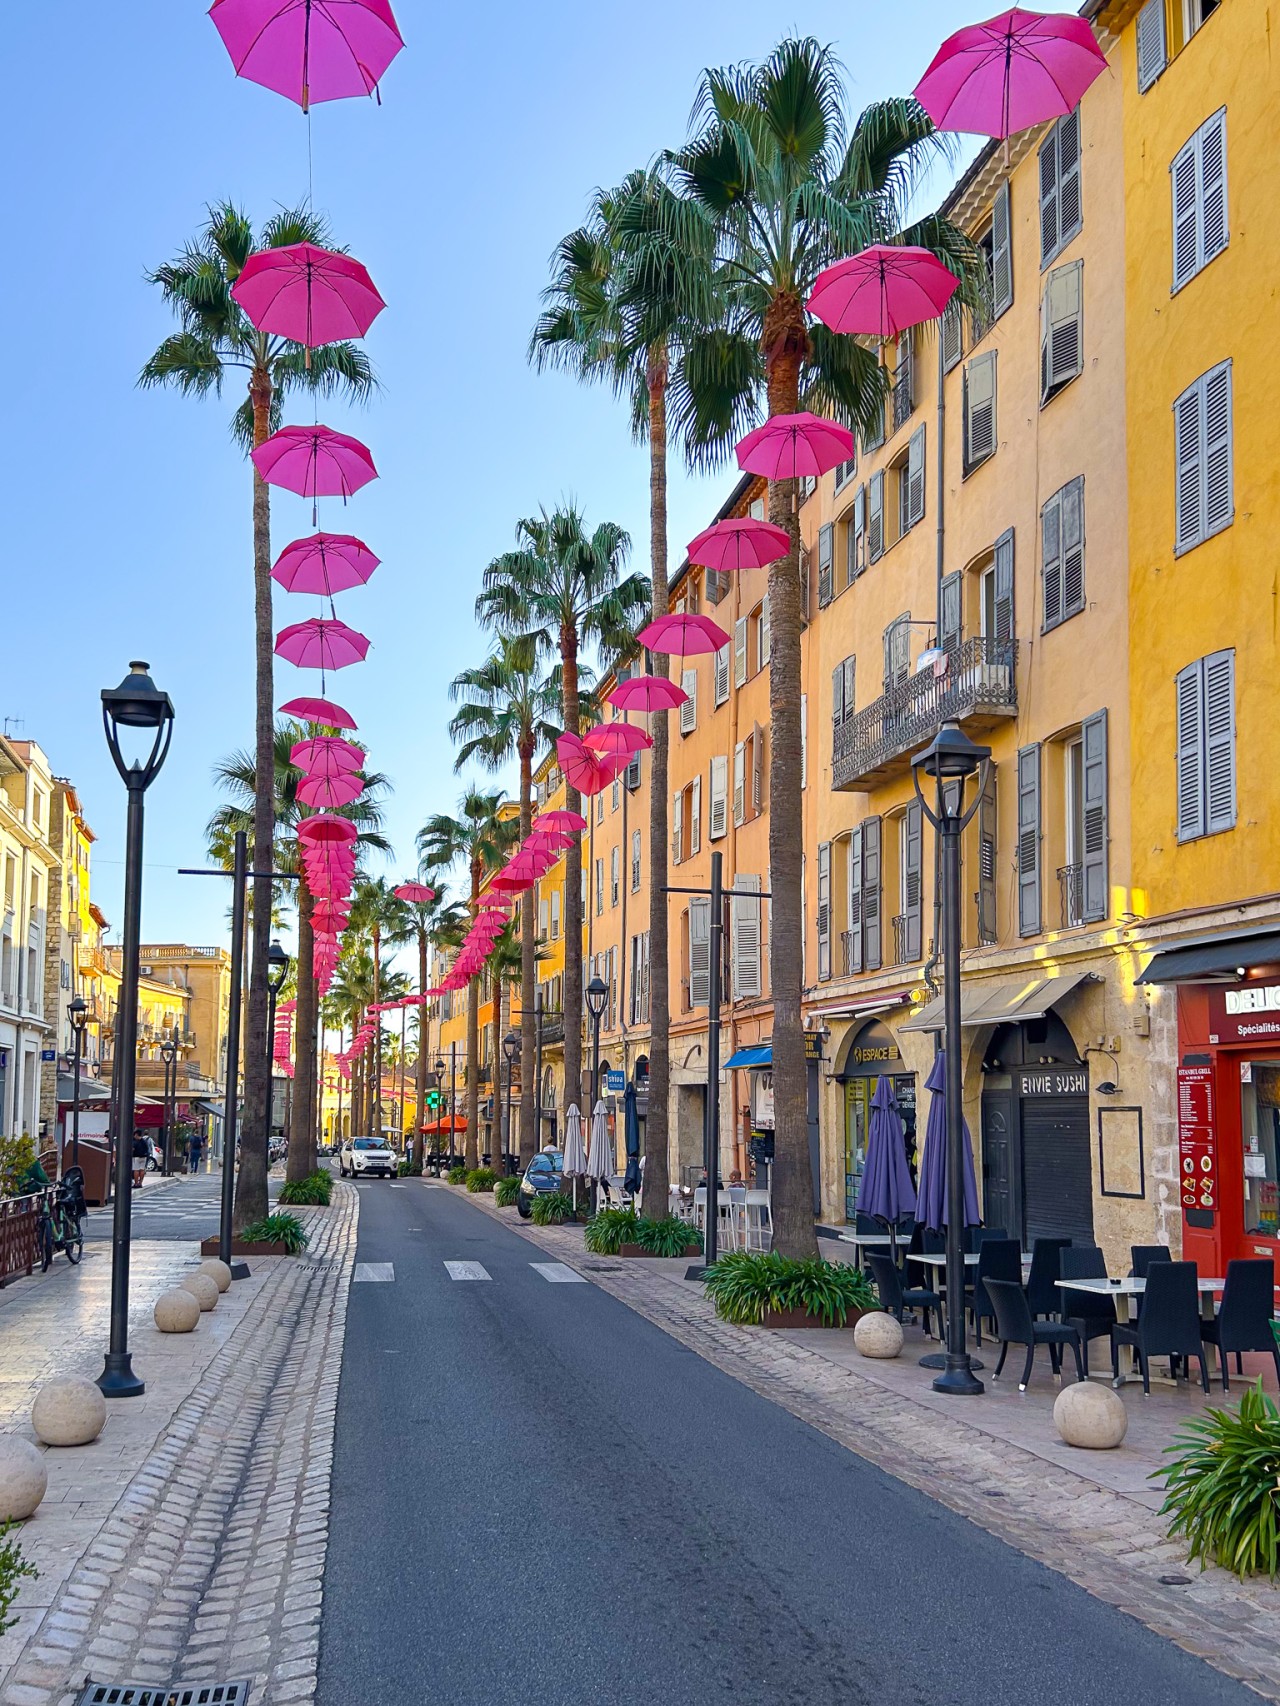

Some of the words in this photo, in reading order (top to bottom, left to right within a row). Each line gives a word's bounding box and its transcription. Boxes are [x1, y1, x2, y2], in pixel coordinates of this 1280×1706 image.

[863, 1047, 887, 1061] ESPACE
[608, 1074, 623, 1083] shiva
[1022, 1076, 1051, 1093] ENVIE
[1056, 1074, 1086, 1092] SUSHI
